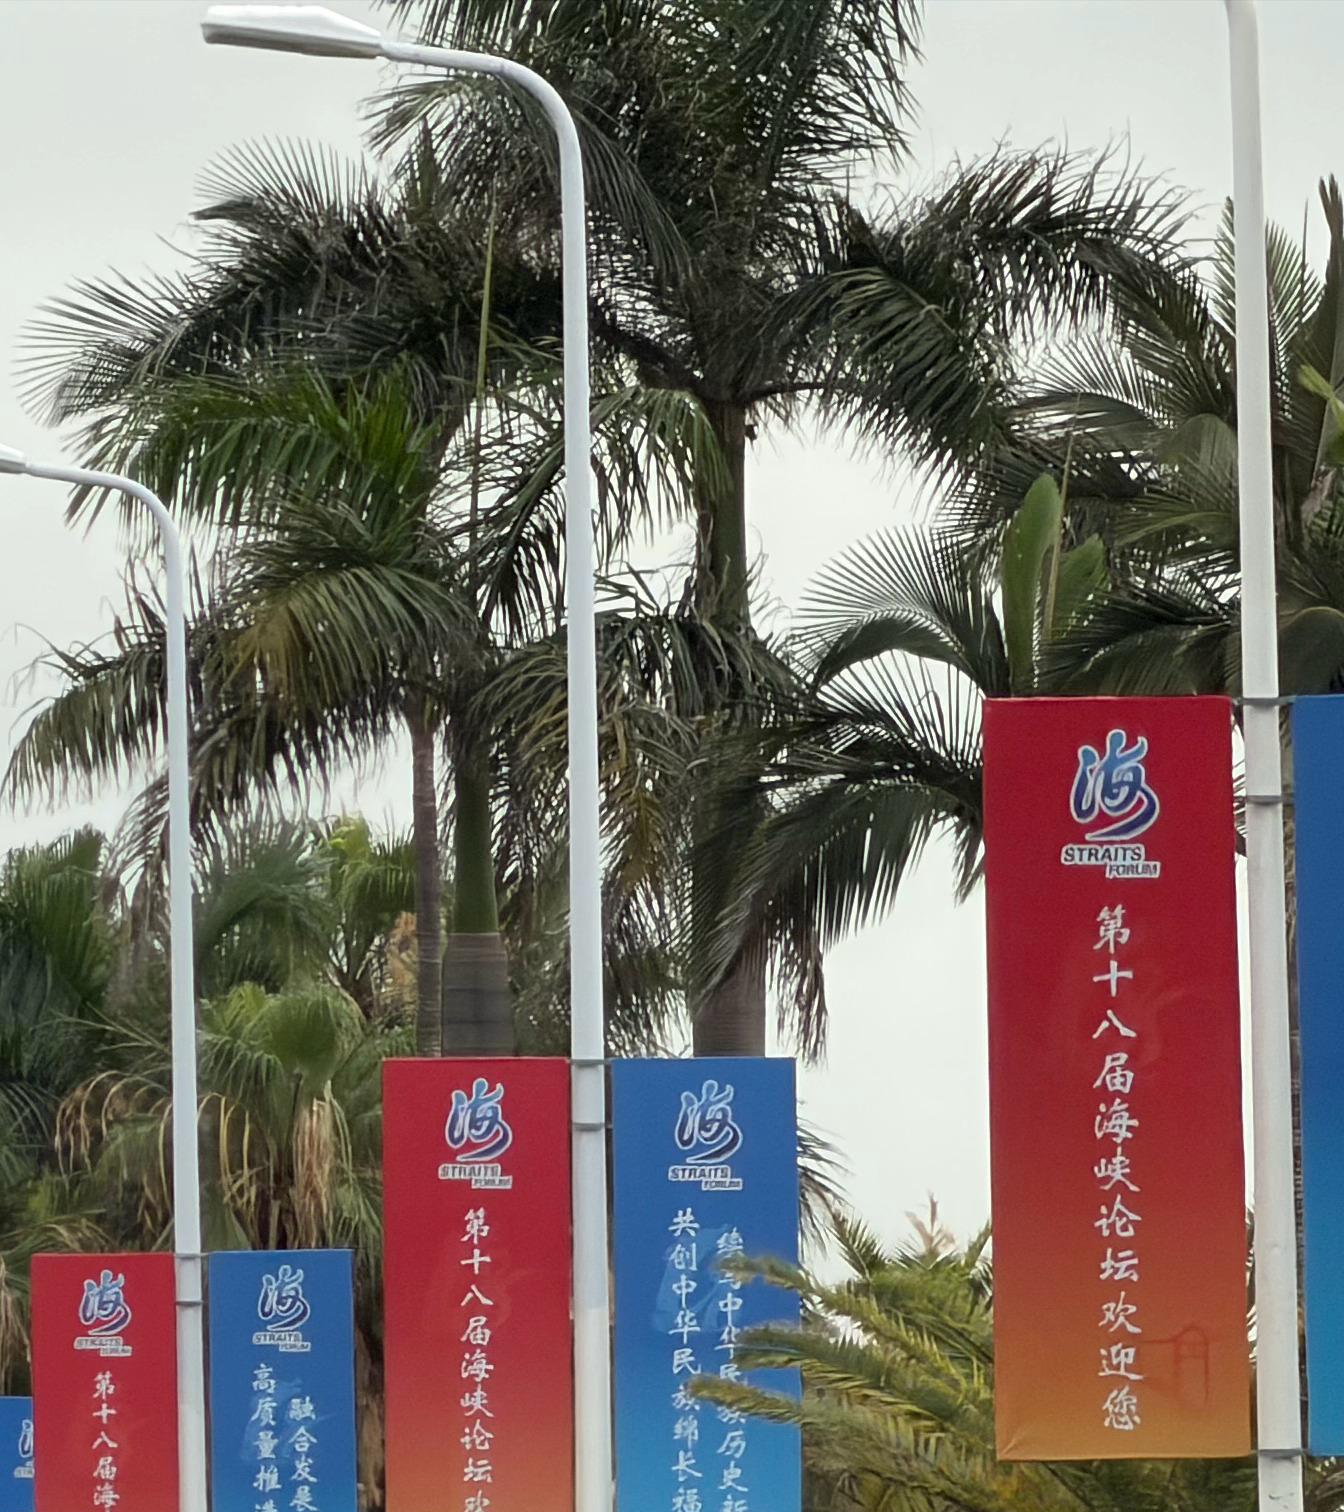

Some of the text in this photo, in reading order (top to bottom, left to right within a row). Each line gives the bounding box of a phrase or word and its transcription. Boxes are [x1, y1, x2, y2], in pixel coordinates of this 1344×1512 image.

[1063, 846, 1143, 862] STRAITS
[1109, 864, 1158, 876] FORUM
[670, 1167, 729, 1178] STRAITS
[1092, 905, 1144, 1431] 第十八届海峡论坛欢迎您
